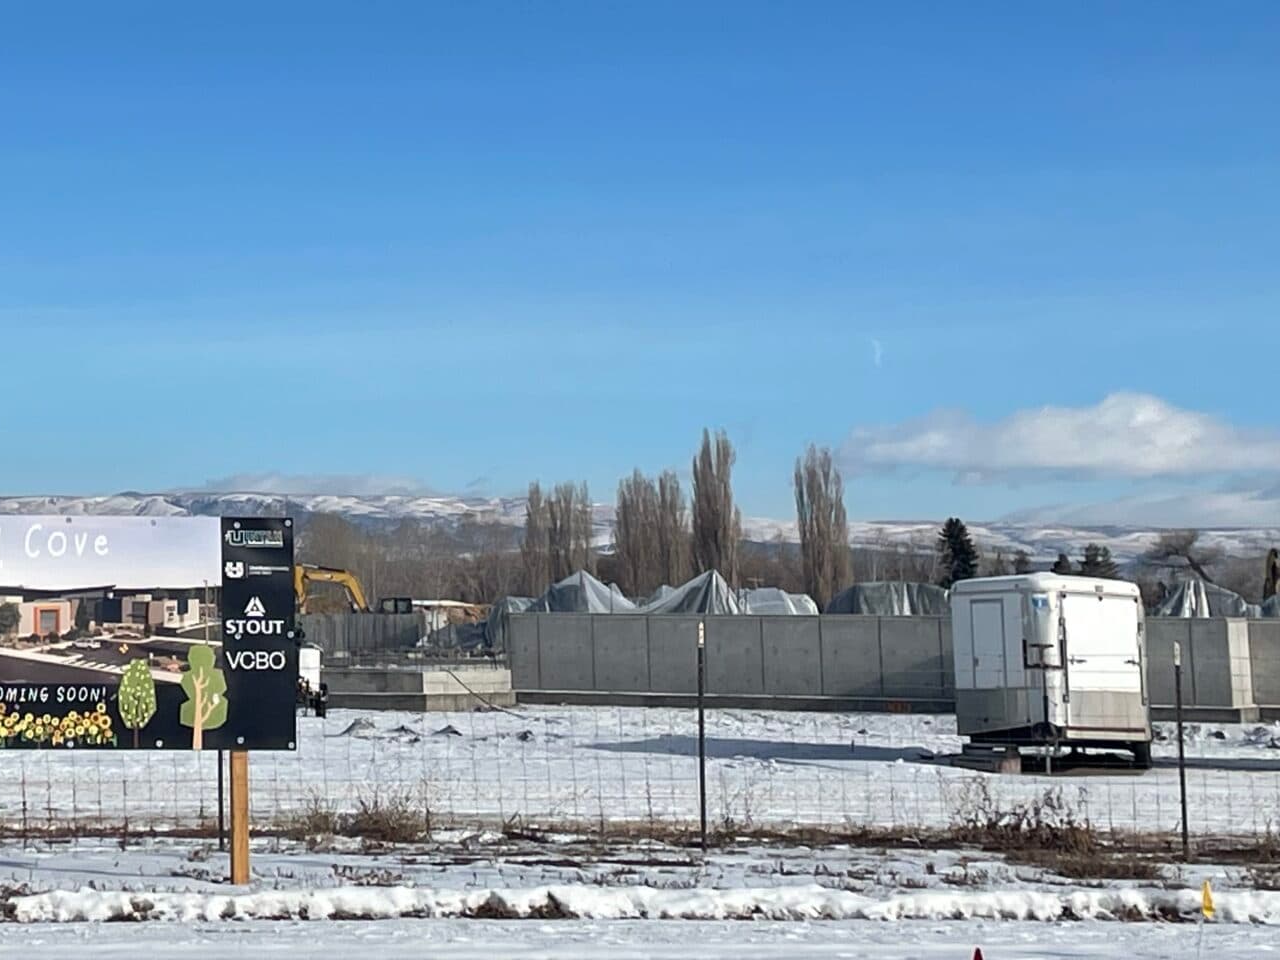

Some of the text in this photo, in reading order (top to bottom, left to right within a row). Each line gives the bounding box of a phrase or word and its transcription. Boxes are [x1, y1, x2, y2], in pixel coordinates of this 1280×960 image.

[25, 523, 109, 558] Cove
[225, 619, 285, 635] STOUT
[225, 651, 286, 670] VCBO
[56, 686, 106, 704] SOON!
